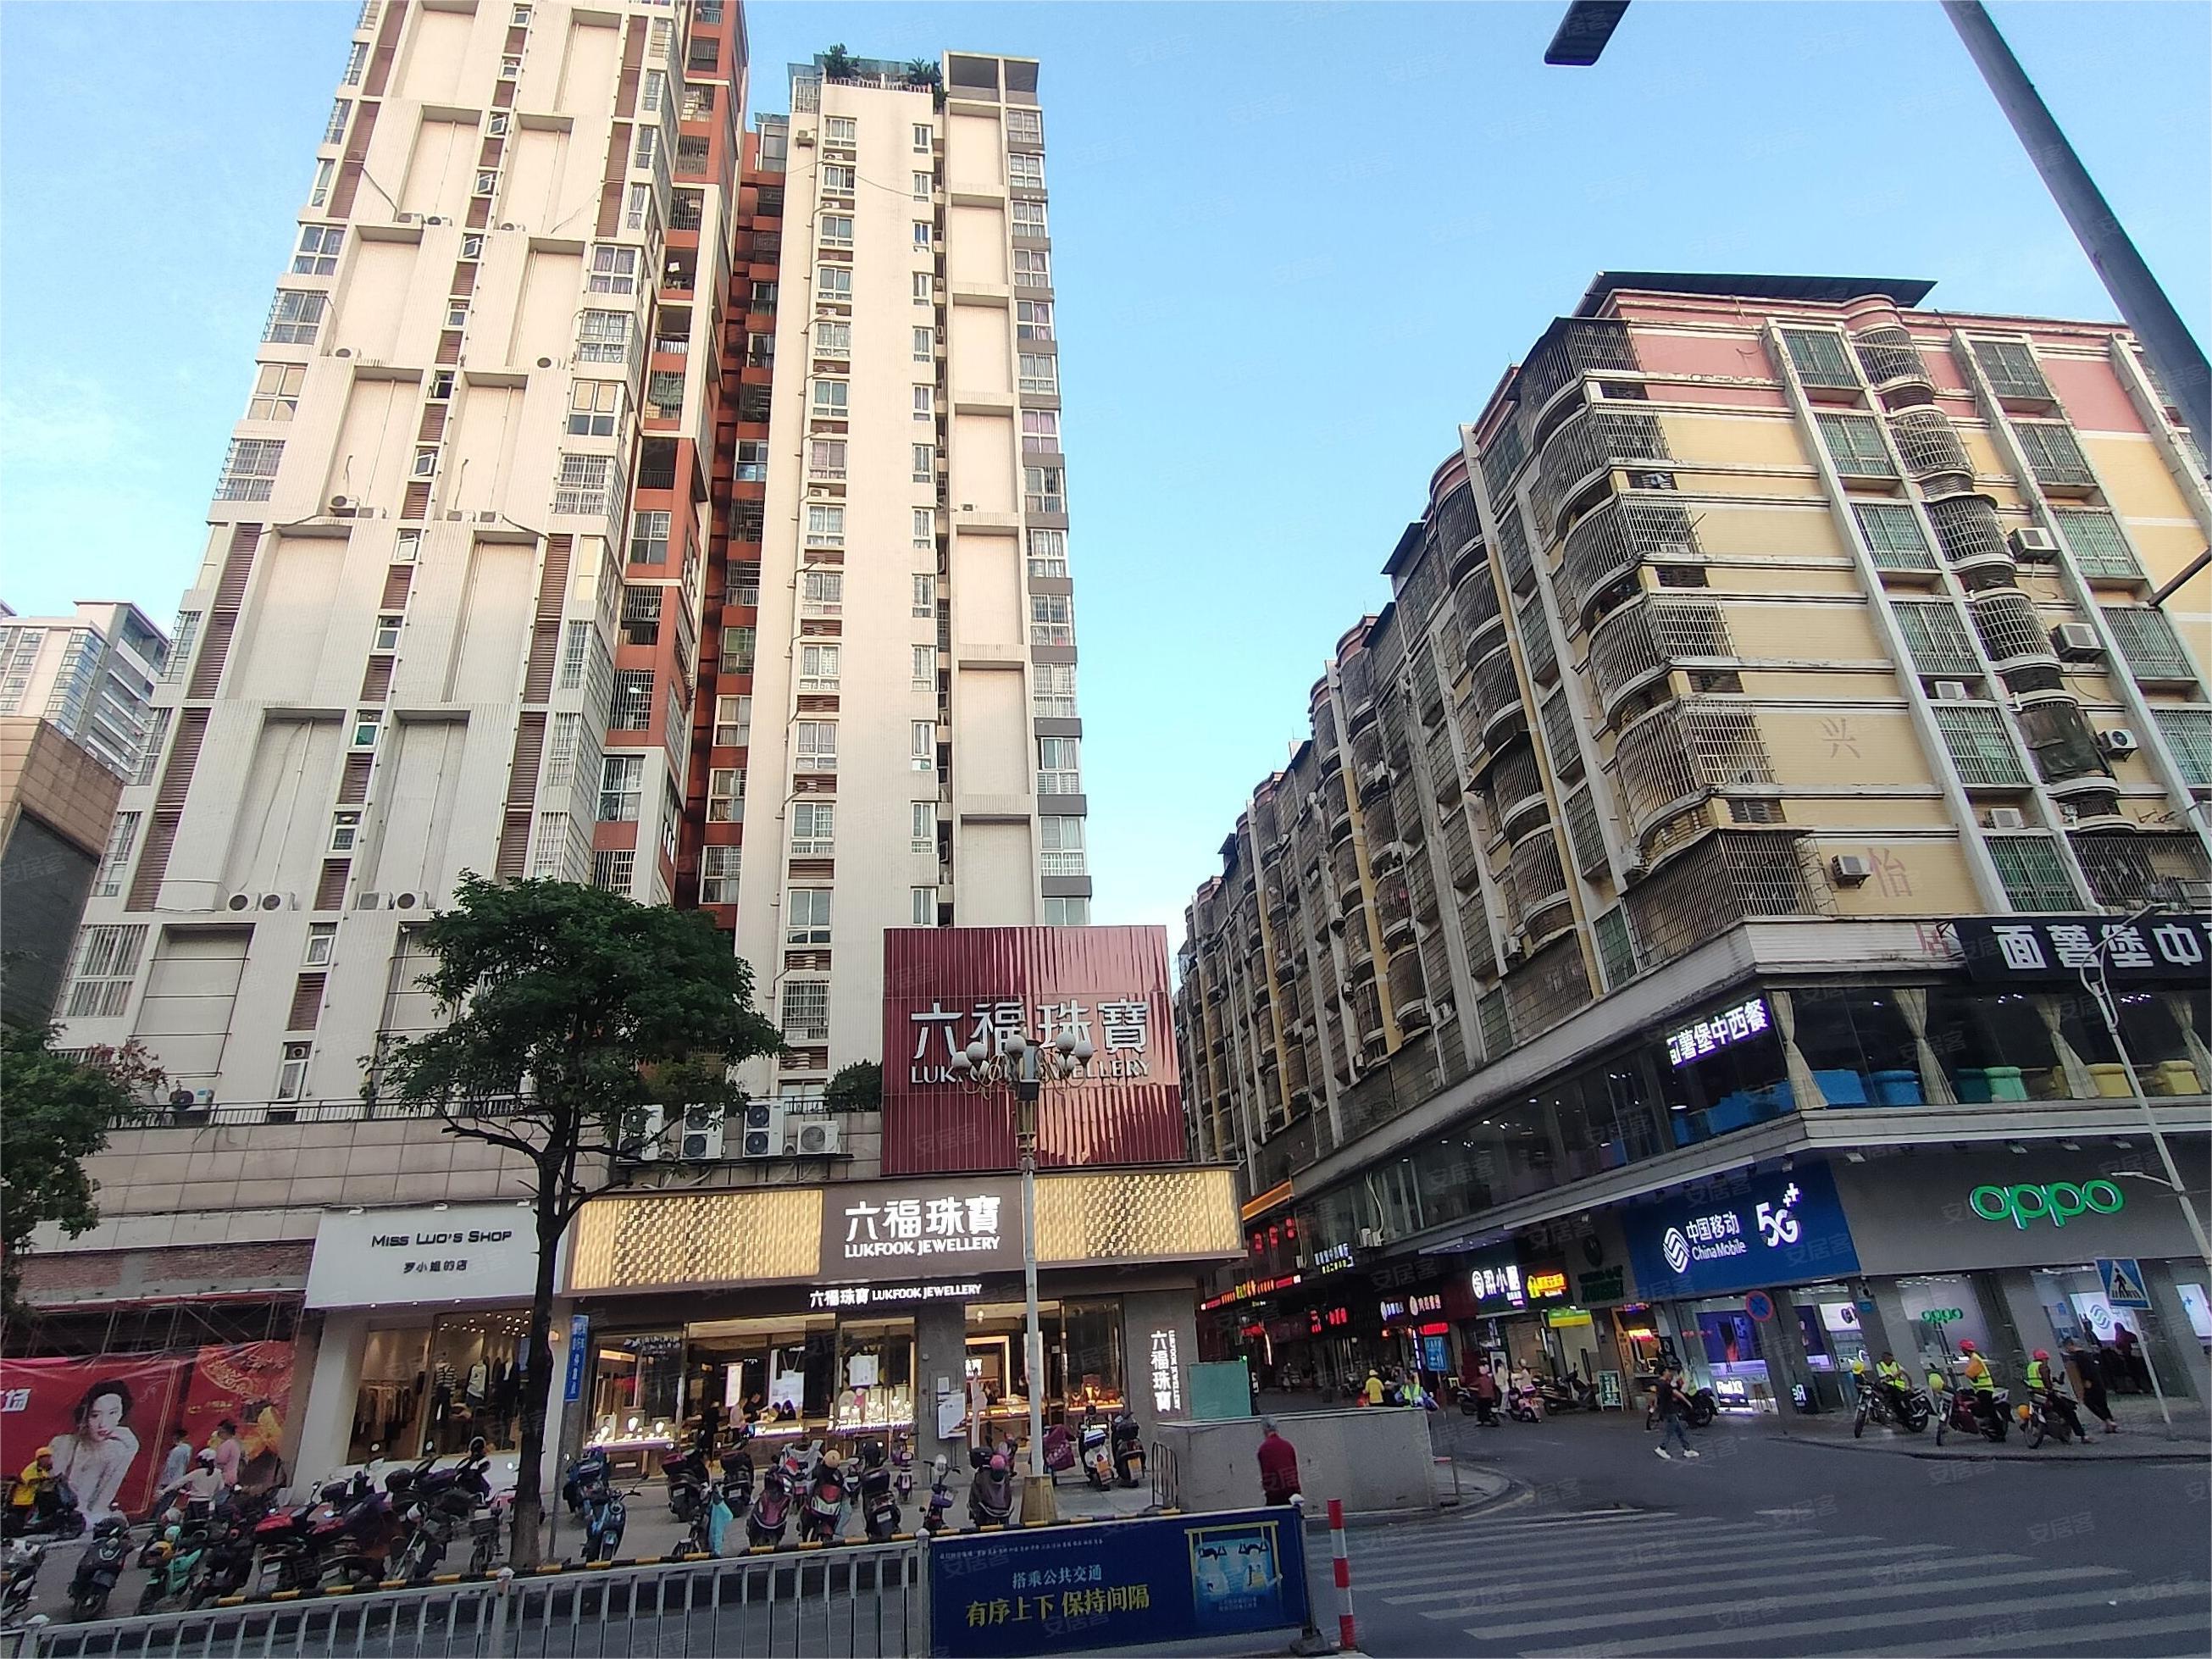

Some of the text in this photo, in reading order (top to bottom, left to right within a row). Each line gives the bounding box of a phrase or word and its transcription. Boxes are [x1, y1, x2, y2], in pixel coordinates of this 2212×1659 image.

[1991, 924, 2212, 968] 面薯堡中
[910, 998, 1149, 1059] 六福珠寶
[845, 1195, 1001, 1242] 六福珠寶
[1686, 1211, 1740, 1243] 中国移动
[468, 1230, 513, 1243] SHOP
[845, 1235, 1001, 1258] LUKFOOK JEWELLERY
[403, 1259, 468, 1274] 罗小姐的店
[810, 1284, 982, 1308] 六福珠寶 LUKFOOK JEWELLERY
[1012, 1564, 1102, 1590] 搭乘公共交通
[966, 1584, 1150, 1632] 有序上下 保持间隔
